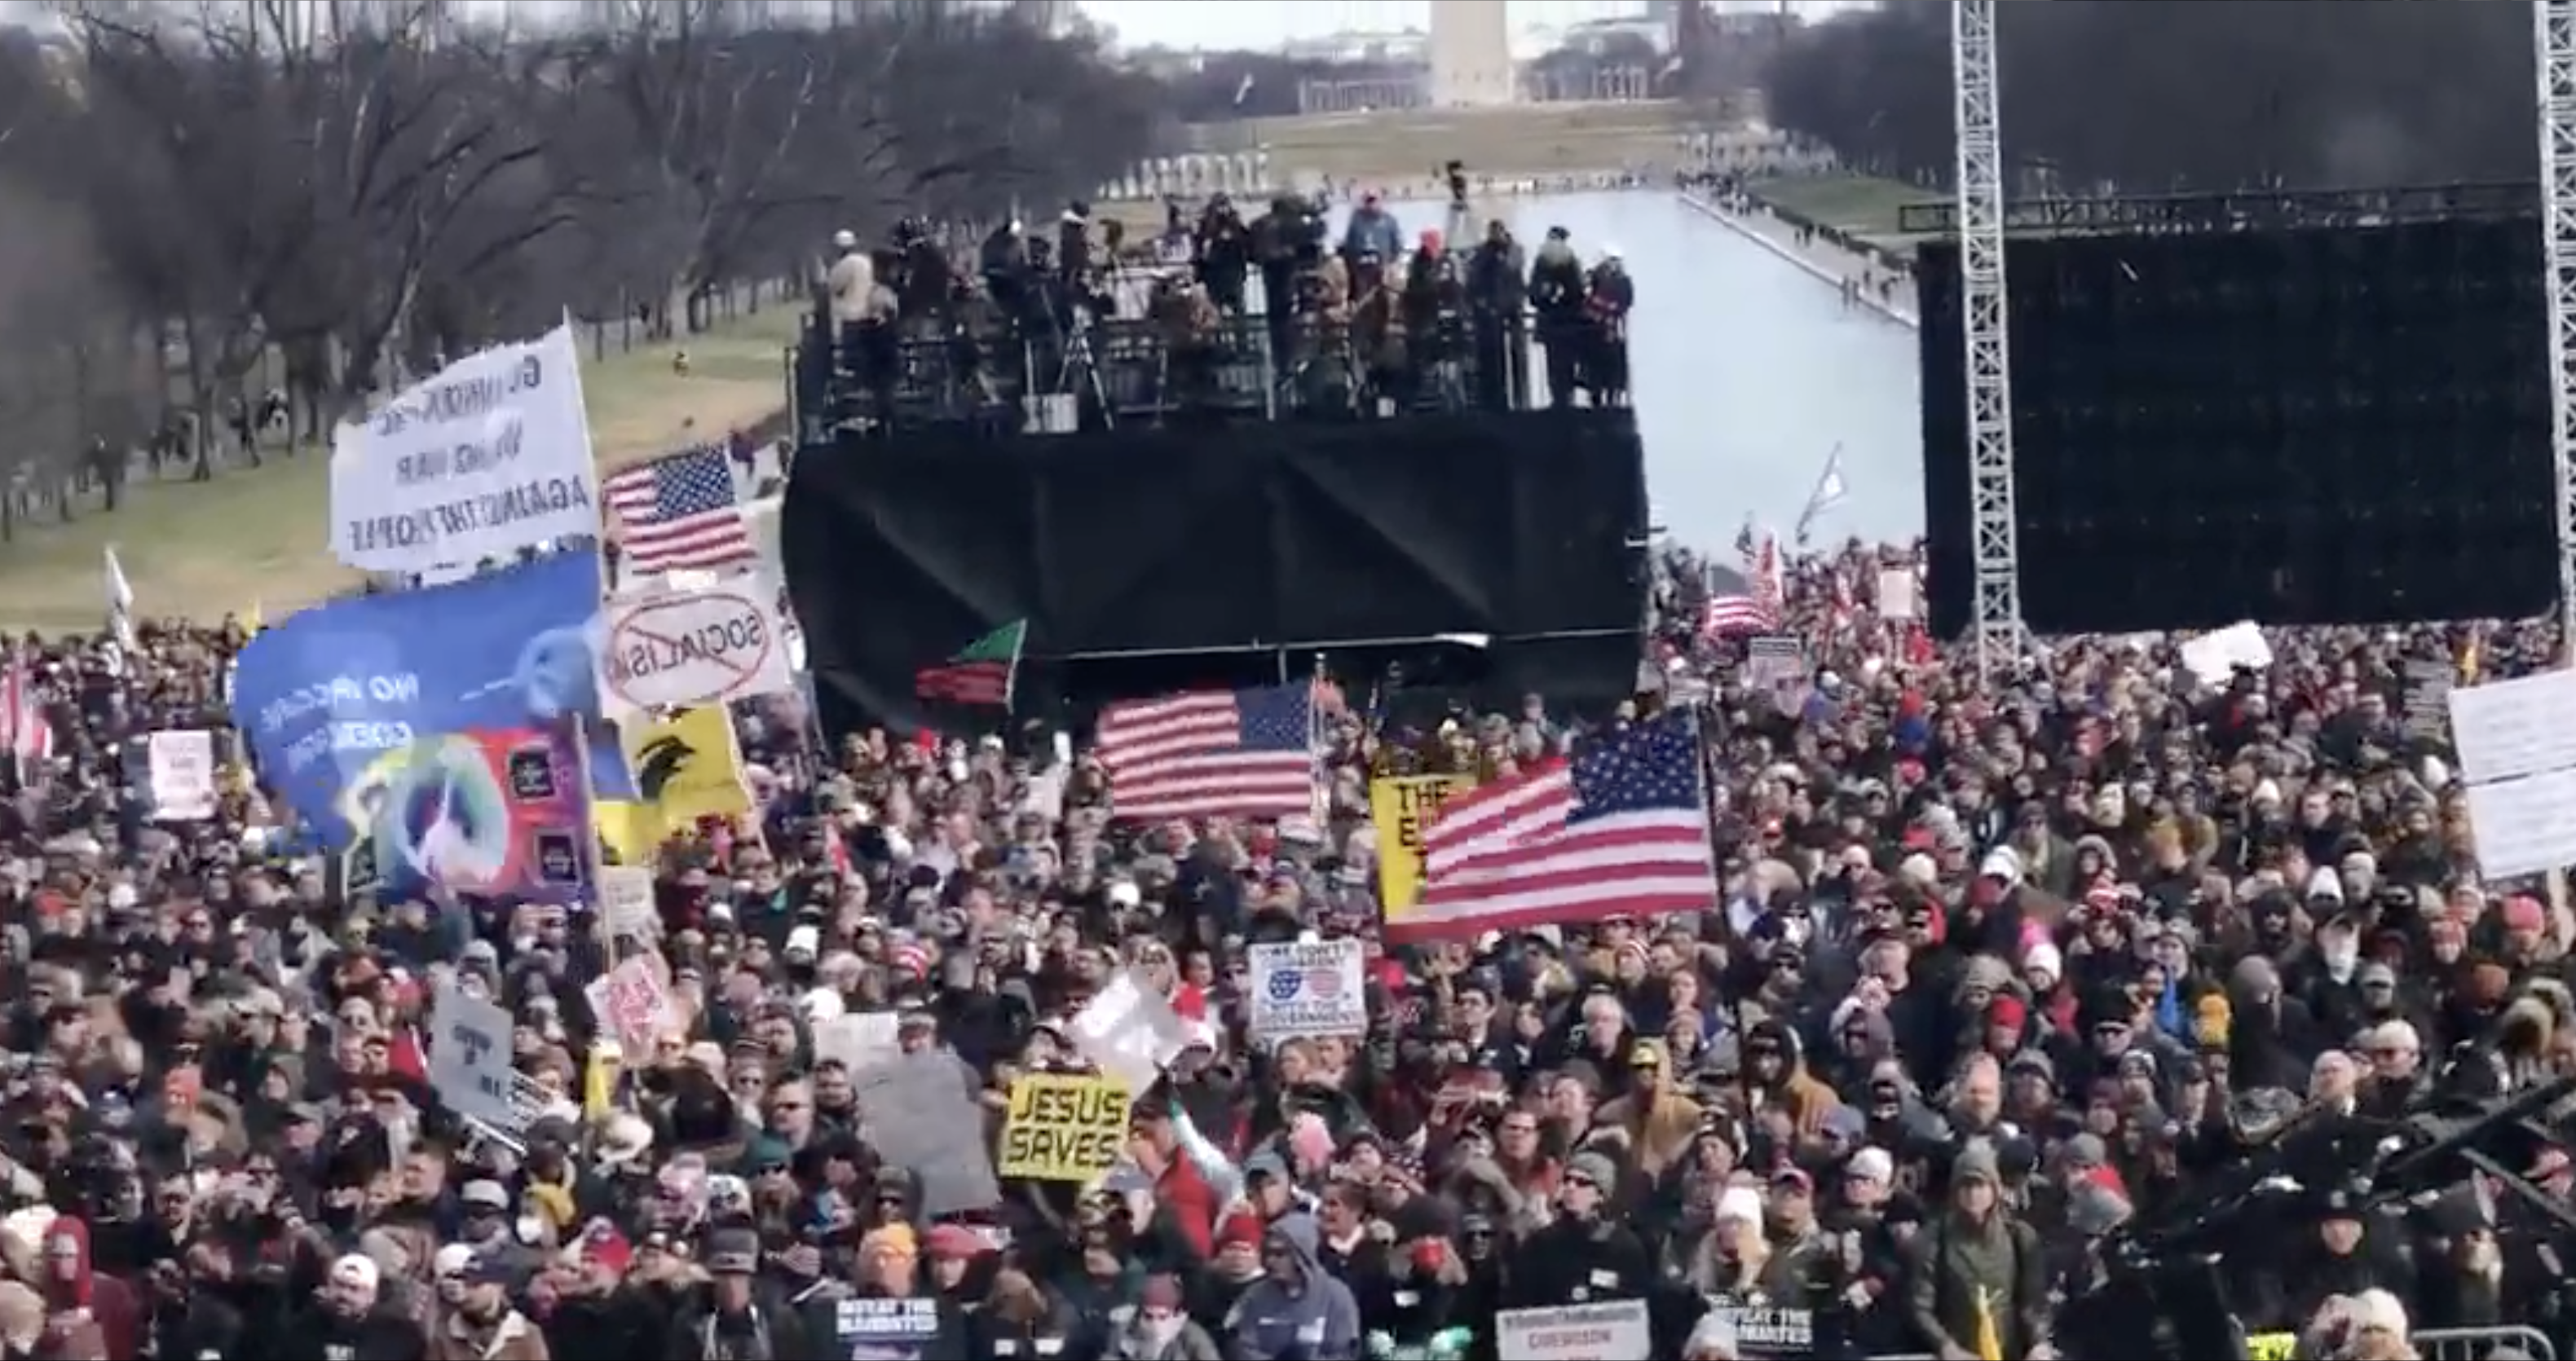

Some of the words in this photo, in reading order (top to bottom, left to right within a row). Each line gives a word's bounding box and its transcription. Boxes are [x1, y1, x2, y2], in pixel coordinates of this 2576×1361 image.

[1392, 780, 1450, 811] THE
[1015, 1085, 1128, 1126] JESUS
[1007, 1126, 1121, 1169] SAVES
[902, 1297, 936, 1314] THE
[1781, 1306, 1813, 1325] THE
